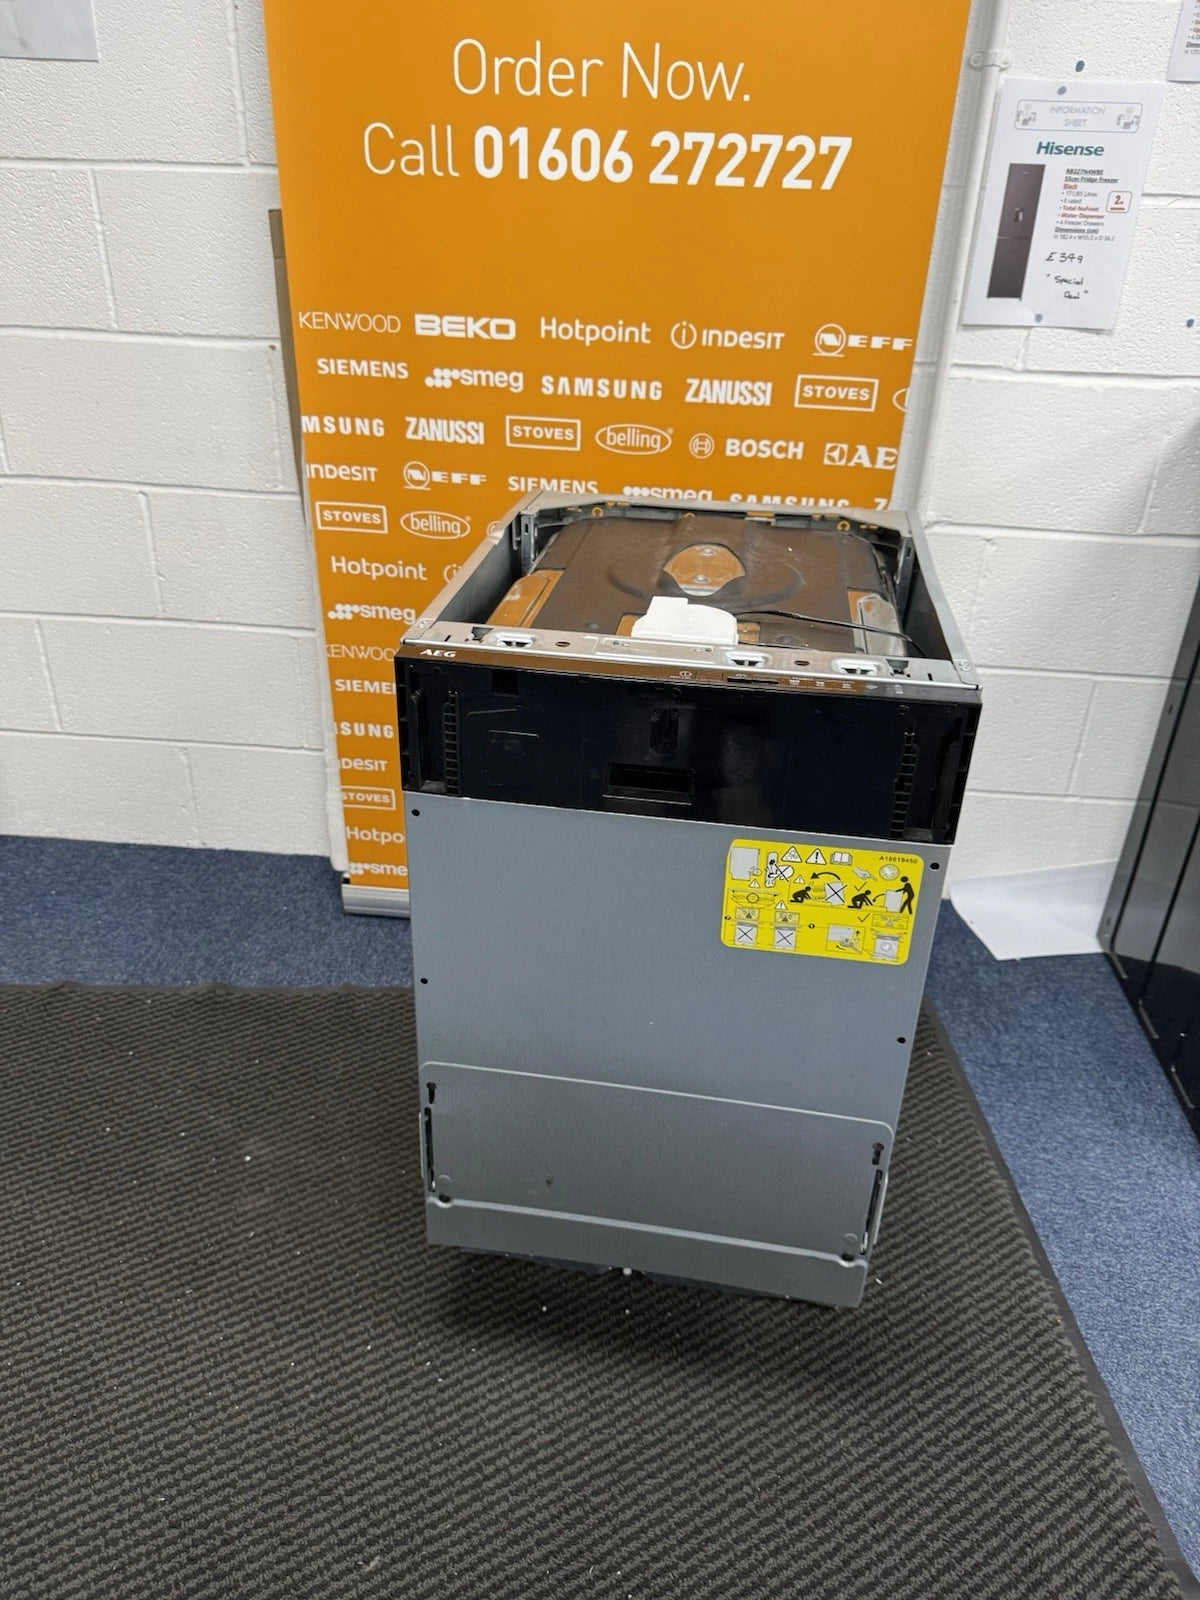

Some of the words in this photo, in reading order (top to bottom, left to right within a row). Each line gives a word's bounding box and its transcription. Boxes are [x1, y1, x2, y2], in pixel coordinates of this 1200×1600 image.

[454, 39, 603, 96] Order
[622, 42, 750, 101] Now.
[1050, 105, 1106, 115] INFORMATION
[1063, 119, 1087, 127] SHEET
[364, 122, 459, 176] Call
[474, 125, 633, 182] 01606
[649, 130, 852, 190] 272727
[1036, 141, 1105, 156] Hisense
[299, 312, 400, 332] KENWOOD
[415, 314, 516, 340] BEKO
[541, 317, 650, 346] Hotpoint
[317, 358, 408, 378] SIEMENS
[460, 369, 523, 392] smeg
[542, 375, 662, 400] SAMSUNG
[685, 378, 772, 406] ZANUSSI
[803, 385, 869, 400] STOVES
[406, 417, 484, 444] ZANUSSI
[513, 426, 574, 440] STOVES
[606, 426, 660, 450] belling
[726, 438, 804, 459] BOSCH
[323, 510, 381, 523] STOVES
[410, 514, 461, 537] belling
[331, 556, 427, 579] Hotpoint
[360, 605, 417, 624] smeg
[420, 648, 456, 658] AEG
[335, 678, 396, 695] SIEME
[335, 721, 394, 739] SUNG
